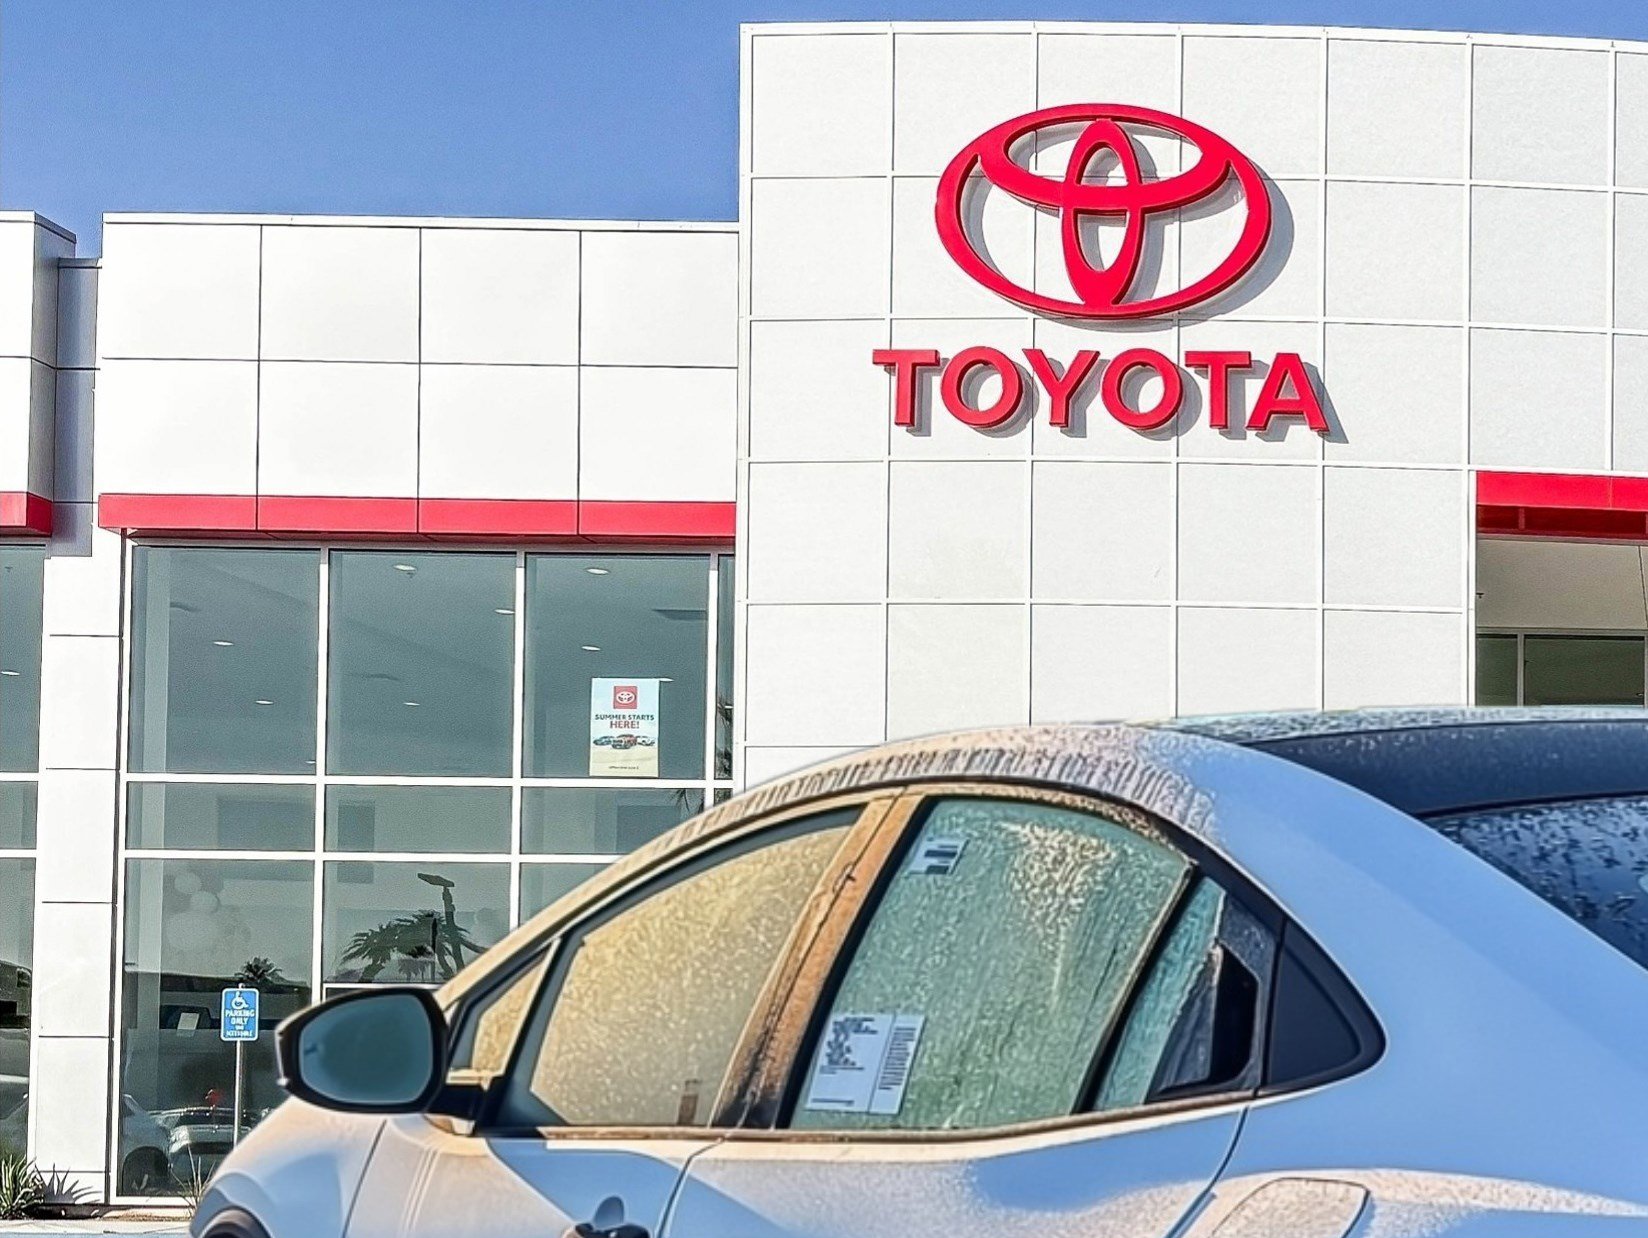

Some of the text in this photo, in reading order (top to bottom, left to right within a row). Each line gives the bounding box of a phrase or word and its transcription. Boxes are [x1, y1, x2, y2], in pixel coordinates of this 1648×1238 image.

[872, 345, 1329, 432] TOYOTA
[594, 713, 655, 721] SUMMER STARTS
[609, 720, 640, 729] HERE!
[225, 1008, 255, 1017] PARKING
[230, 1016, 249, 1025] ONLY
